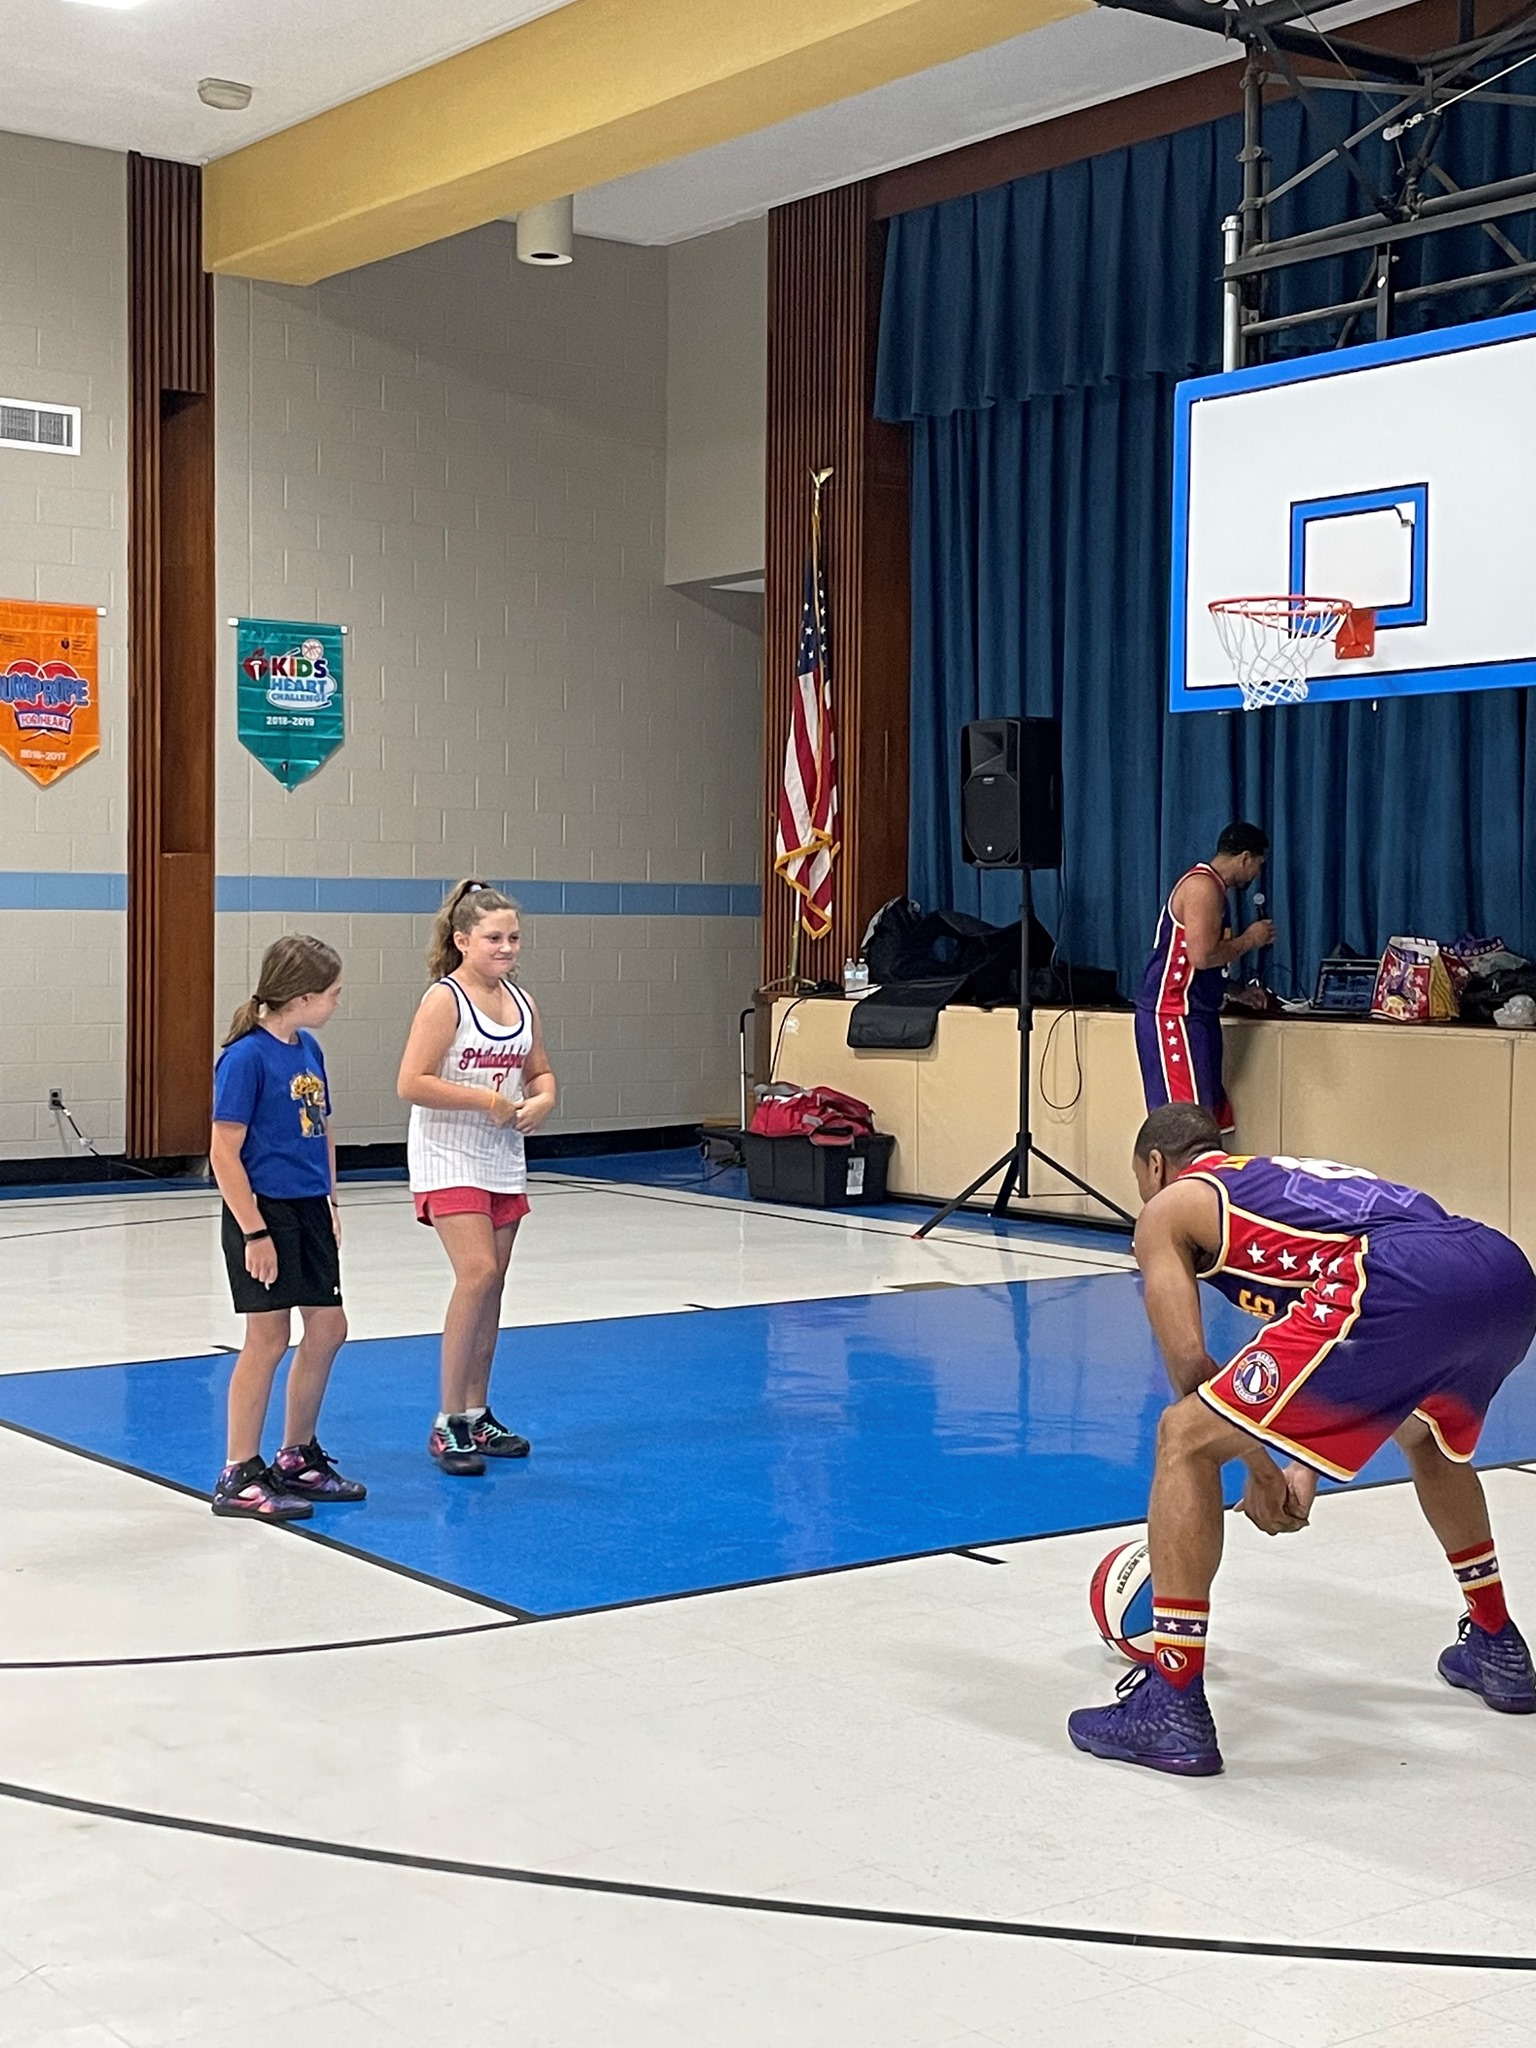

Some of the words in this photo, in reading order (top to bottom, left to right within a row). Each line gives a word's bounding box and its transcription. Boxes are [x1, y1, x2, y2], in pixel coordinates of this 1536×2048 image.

[271, 657, 327, 678] KIDS
[0, 673, 43, 703] UMP
[42, 676, 89, 706] ROPE
[272, 678, 327, 694] HEART
[271, 693, 325, 702] CHALLENGE
[21, 714, 39, 725] FOR
[39, 715, 69, 728] HEART
[266, 716, 315, 727] 2018-2019
[1116, 1558, 1140, 1594] HARLEM
